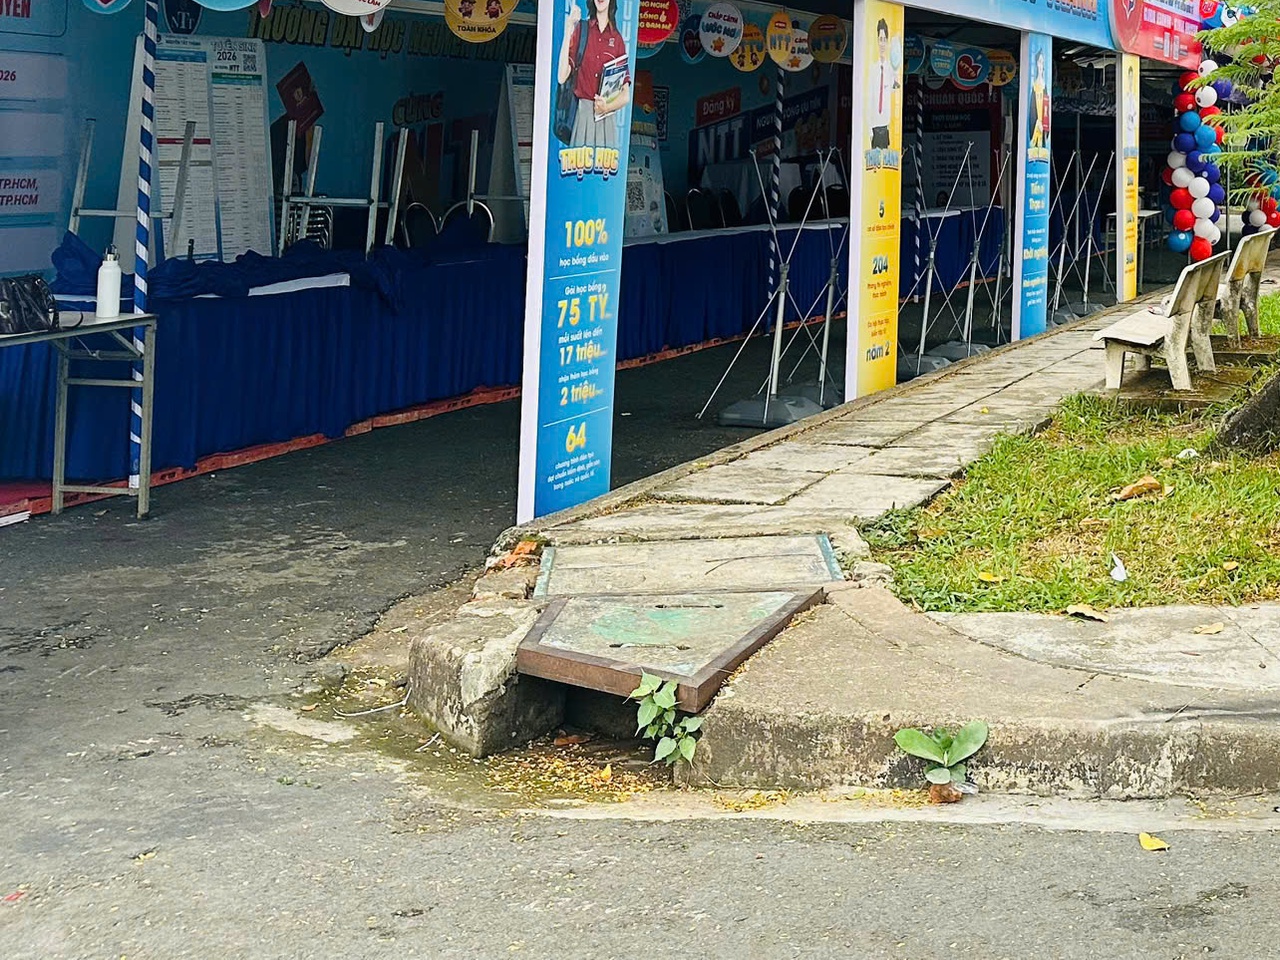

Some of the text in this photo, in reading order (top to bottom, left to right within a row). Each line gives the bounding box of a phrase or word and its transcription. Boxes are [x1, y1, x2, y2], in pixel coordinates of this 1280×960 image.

[216, 51, 237, 61] 2026
[559, 145, 619, 180] THỰC HỌC
[565, 218, 608, 248] 100%
[559, 257, 571, 269] học
[872, 254, 889, 275] 204
[557, 297, 581, 328] 75
[560, 345, 574, 366] 17
[560, 386, 568, 406] 2
[565, 421, 587, 453] 64
